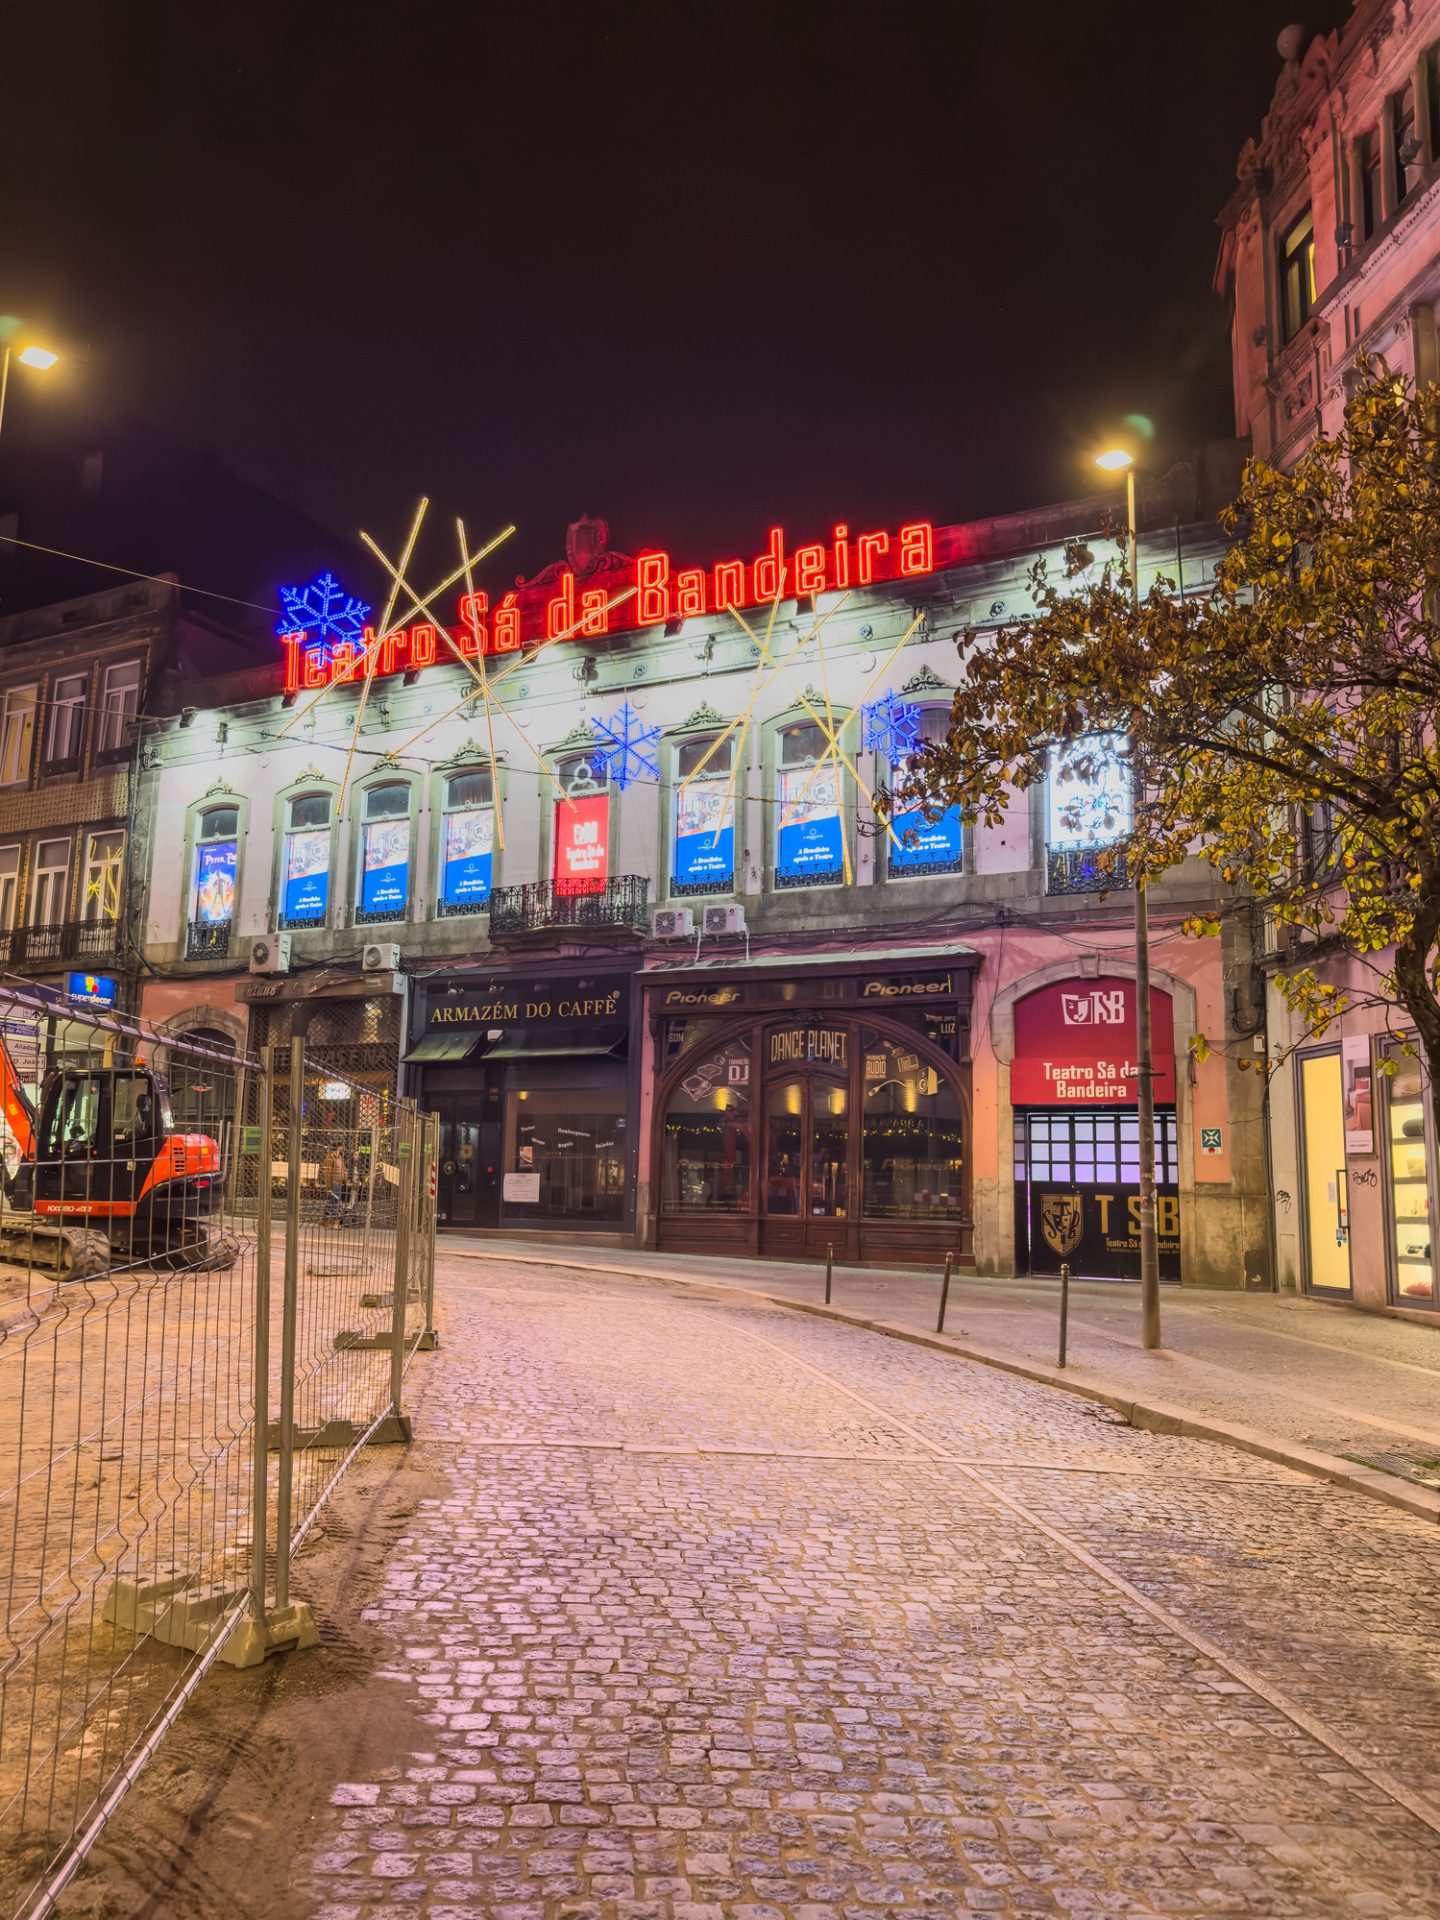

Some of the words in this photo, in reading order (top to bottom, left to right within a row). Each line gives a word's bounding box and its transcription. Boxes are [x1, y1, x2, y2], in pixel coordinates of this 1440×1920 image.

[281, 623, 437, 692] Teatro
[459, 591, 521, 659] Sá
[547, 572, 610, 641] da
[636, 522, 934, 627] Bandeira
[666, 990, 740, 1005] Pioneer
[863, 982, 948, 997] Pioneer
[430, 1001, 518, 1023] ARMAZÉM
[525, 1002, 551, 1018] DO
[940, 1023, 956, 1034] LUZ
[770, 1030, 805, 1063] DANCE
[807, 1029, 847, 1061] PLANET
[728, 1065, 749, 1081] DJ
[1043, 1062, 1094, 1080] Teatro
[1097, 1061, 1116, 1079] Sá
[1120, 1060, 1139, 1079] da
[1056, 1080, 1127, 1098] Bandeira
